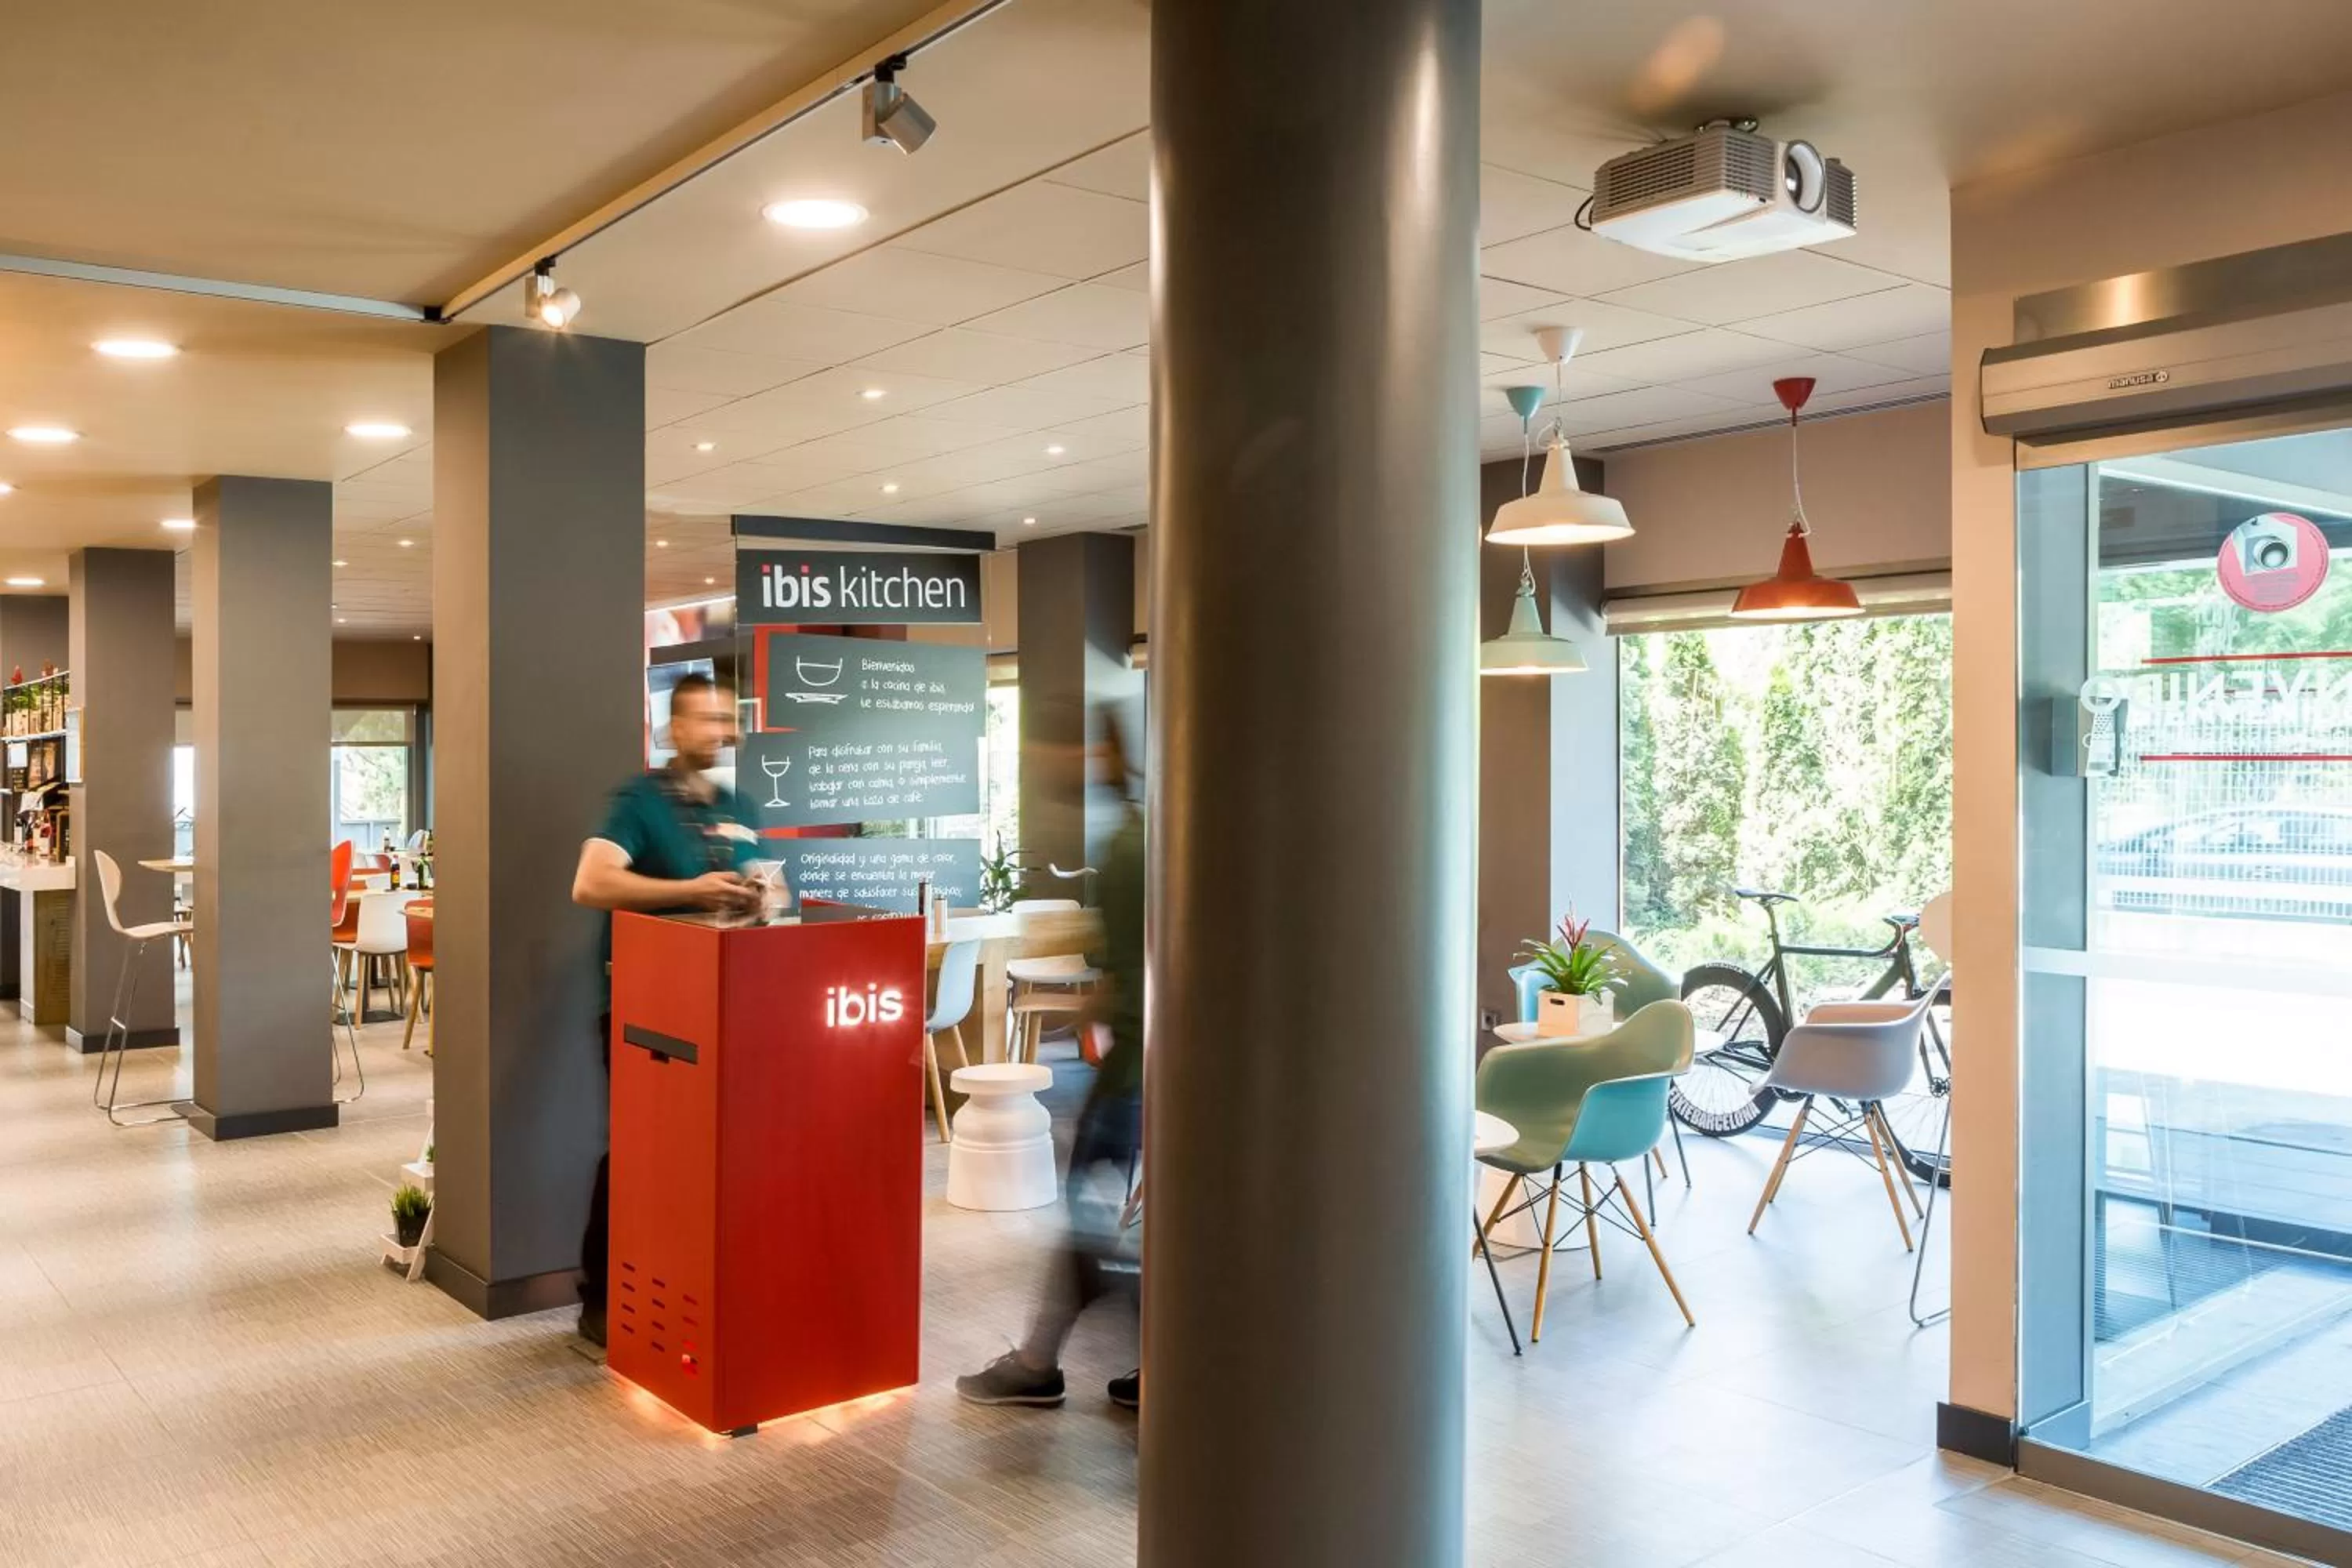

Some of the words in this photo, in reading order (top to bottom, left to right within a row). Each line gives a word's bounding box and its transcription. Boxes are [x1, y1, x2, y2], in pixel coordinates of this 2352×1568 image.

[761, 564, 832, 608] ibis
[840, 565, 966, 608] kitchen
[826, 982, 904, 1028] ibis
